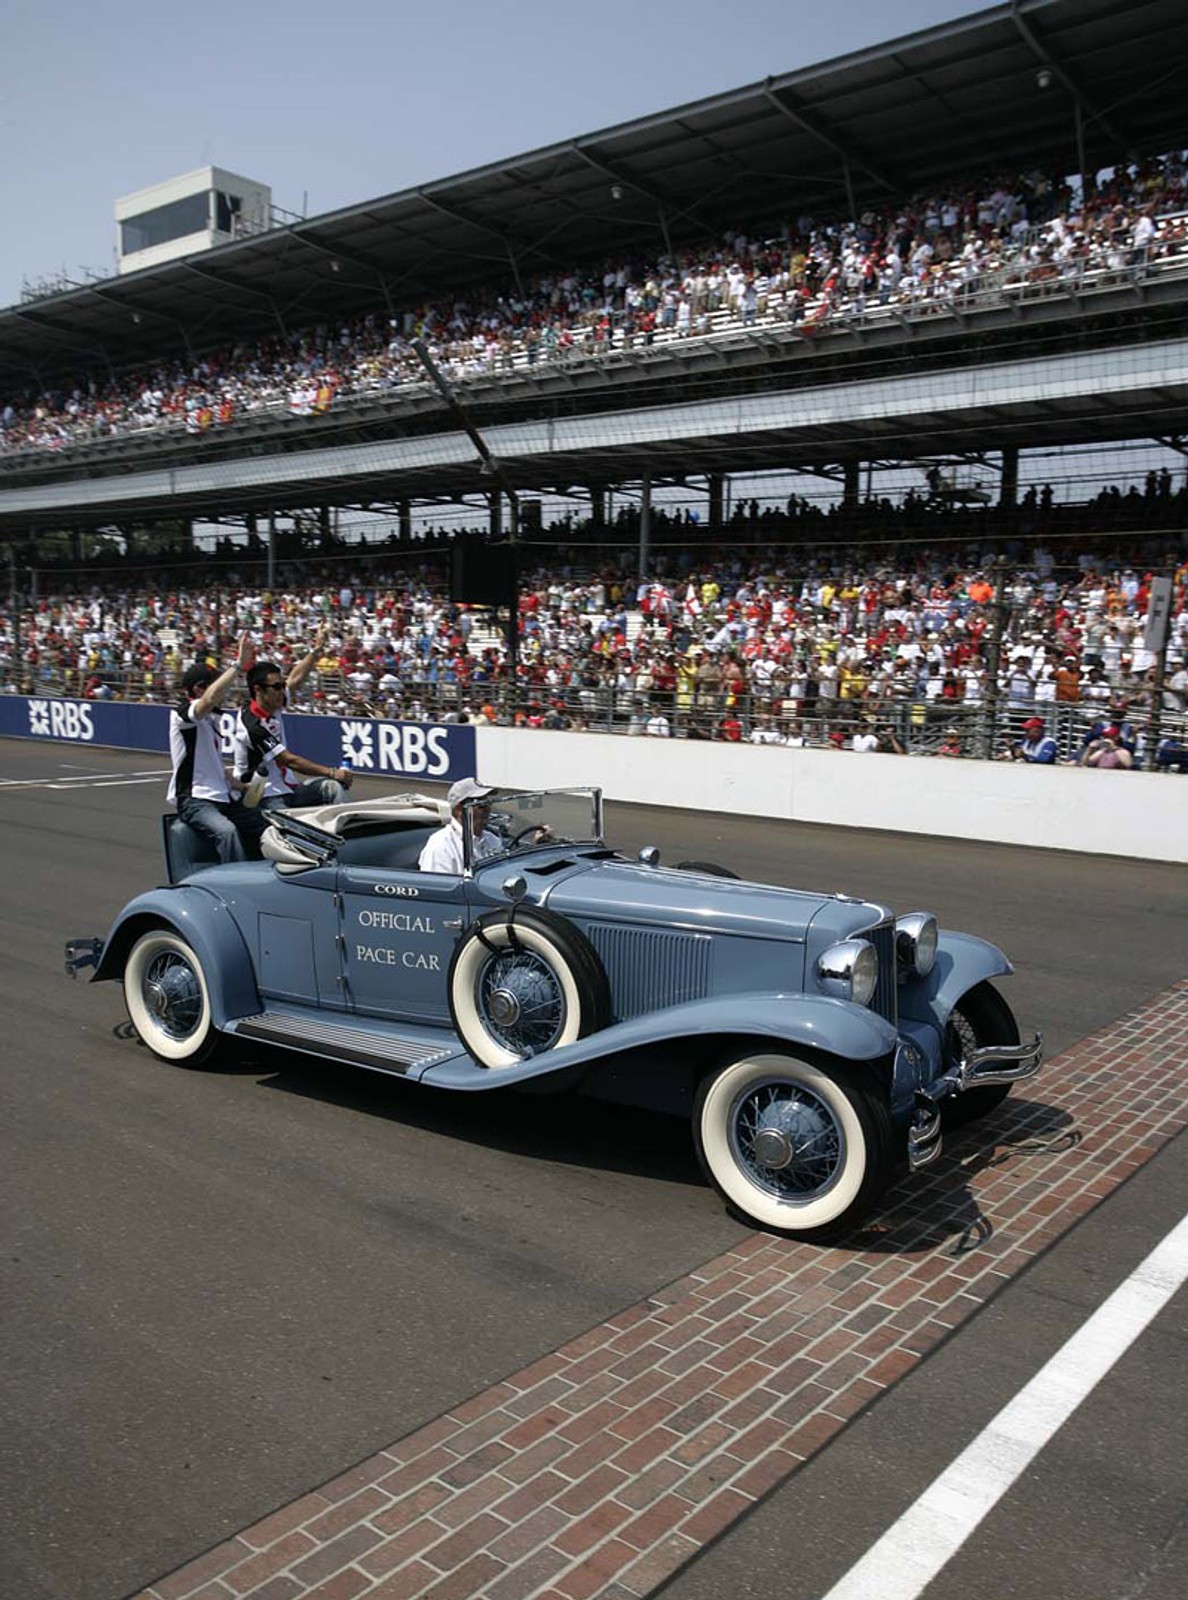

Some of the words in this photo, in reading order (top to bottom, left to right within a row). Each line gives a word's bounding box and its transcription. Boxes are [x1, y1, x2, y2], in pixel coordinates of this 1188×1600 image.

[50, 700, 94, 740] RBS
[378, 723, 450, 775] RBS
[374, 884, 419, 896] CORD
[358, 910, 435, 933] OFFICIAL
[356, 945, 396, 965] PACE
[402, 951, 440, 971] CAR
